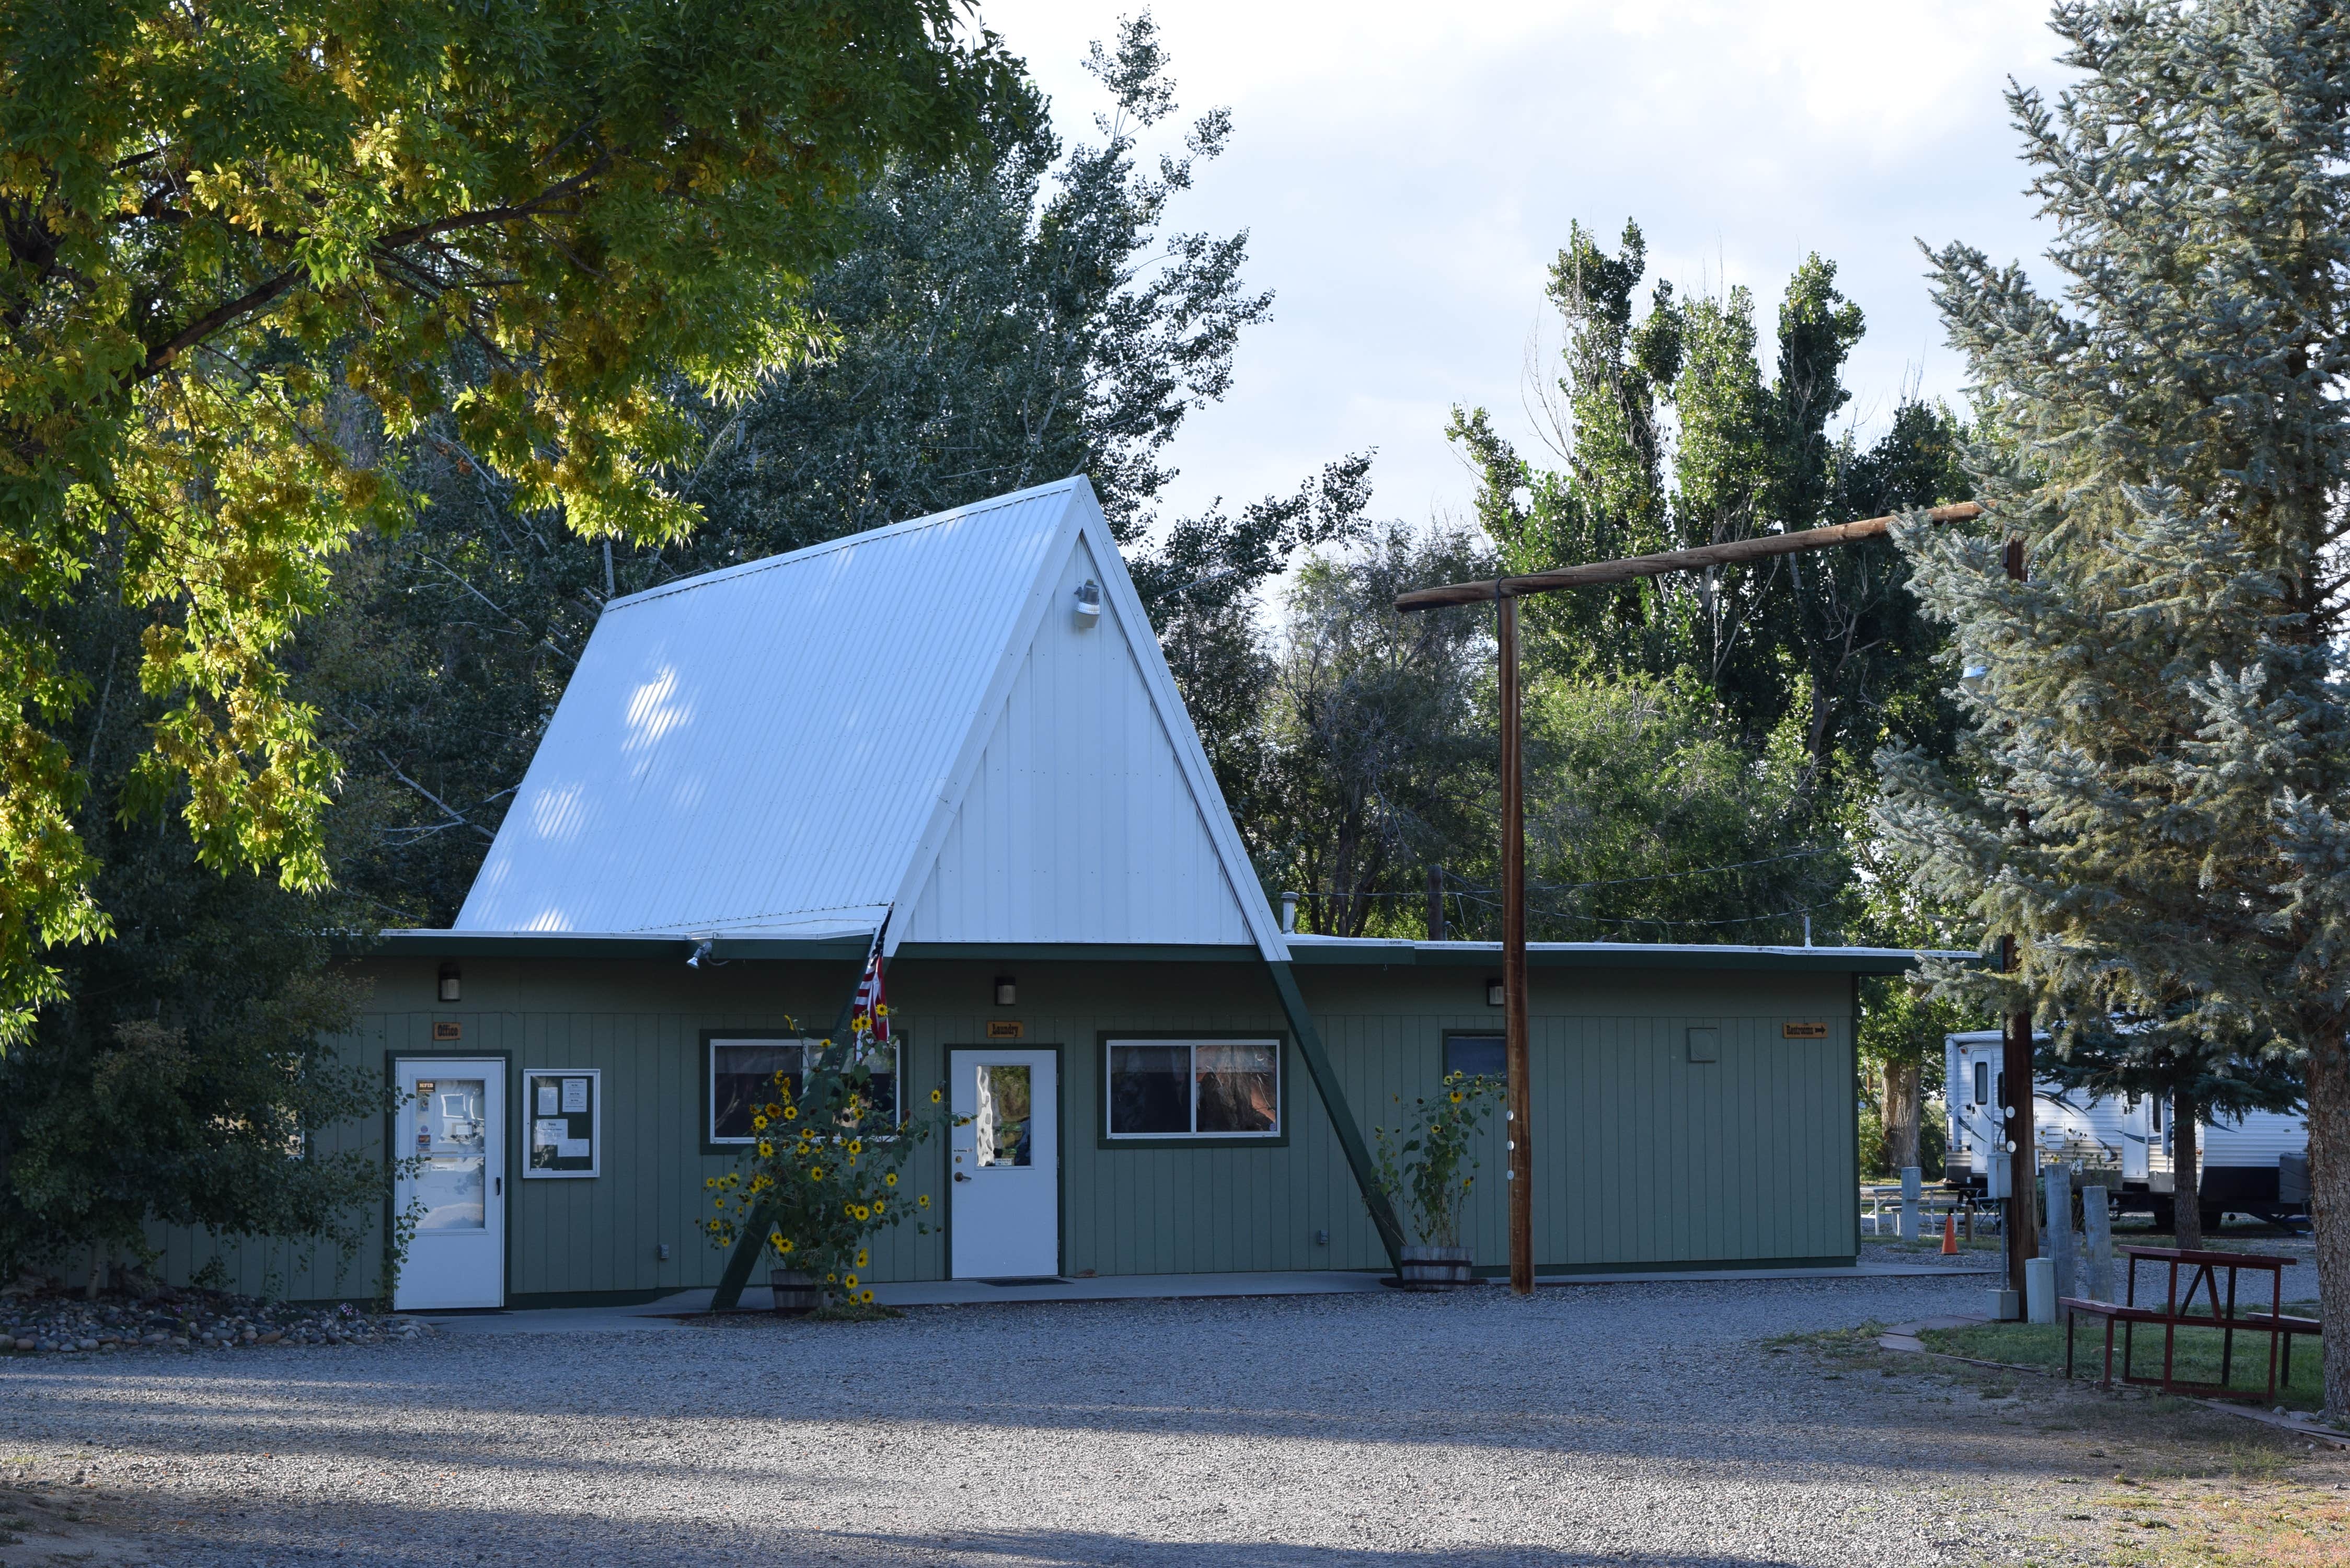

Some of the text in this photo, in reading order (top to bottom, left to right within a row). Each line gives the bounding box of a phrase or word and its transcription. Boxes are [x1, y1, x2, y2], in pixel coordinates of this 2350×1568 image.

[437, 1024, 458, 1037] Office
[992, 1023, 1019, 1037] Laundry
[1786, 1024, 1814, 1035] Restrooms
